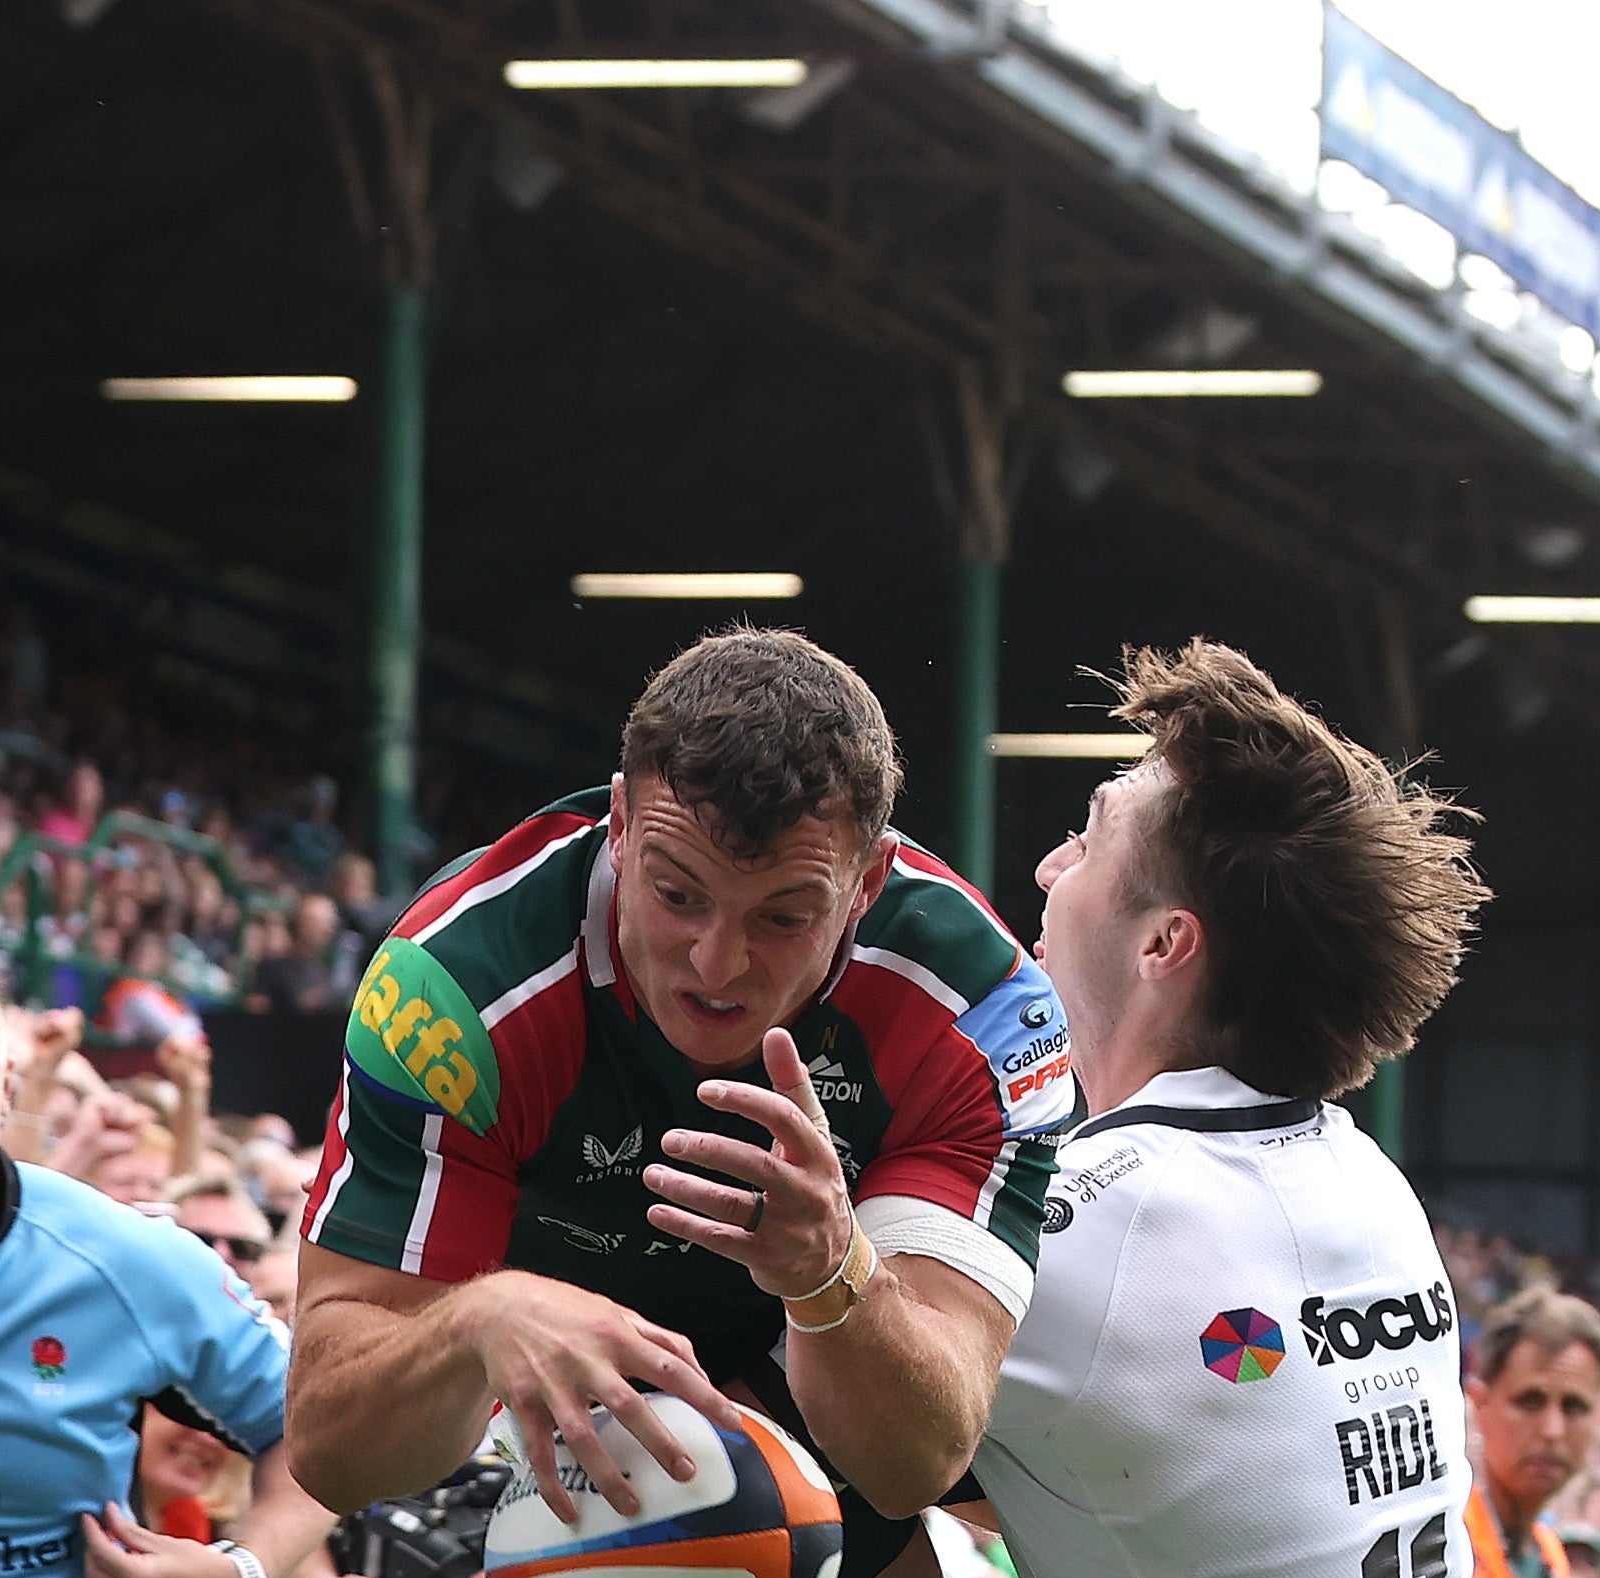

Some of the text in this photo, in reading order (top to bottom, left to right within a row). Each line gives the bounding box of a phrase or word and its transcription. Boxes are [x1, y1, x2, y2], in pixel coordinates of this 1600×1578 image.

[1063, 1145, 1139, 1194] University
[1093, 1156, 1145, 1190] Exeter
[1080, 1186, 1098, 1204] of
[1299, 1281, 1452, 1366] focus
[1344, 1363, 1420, 1403] group
[1335, 1398, 1449, 1506] RIDL
